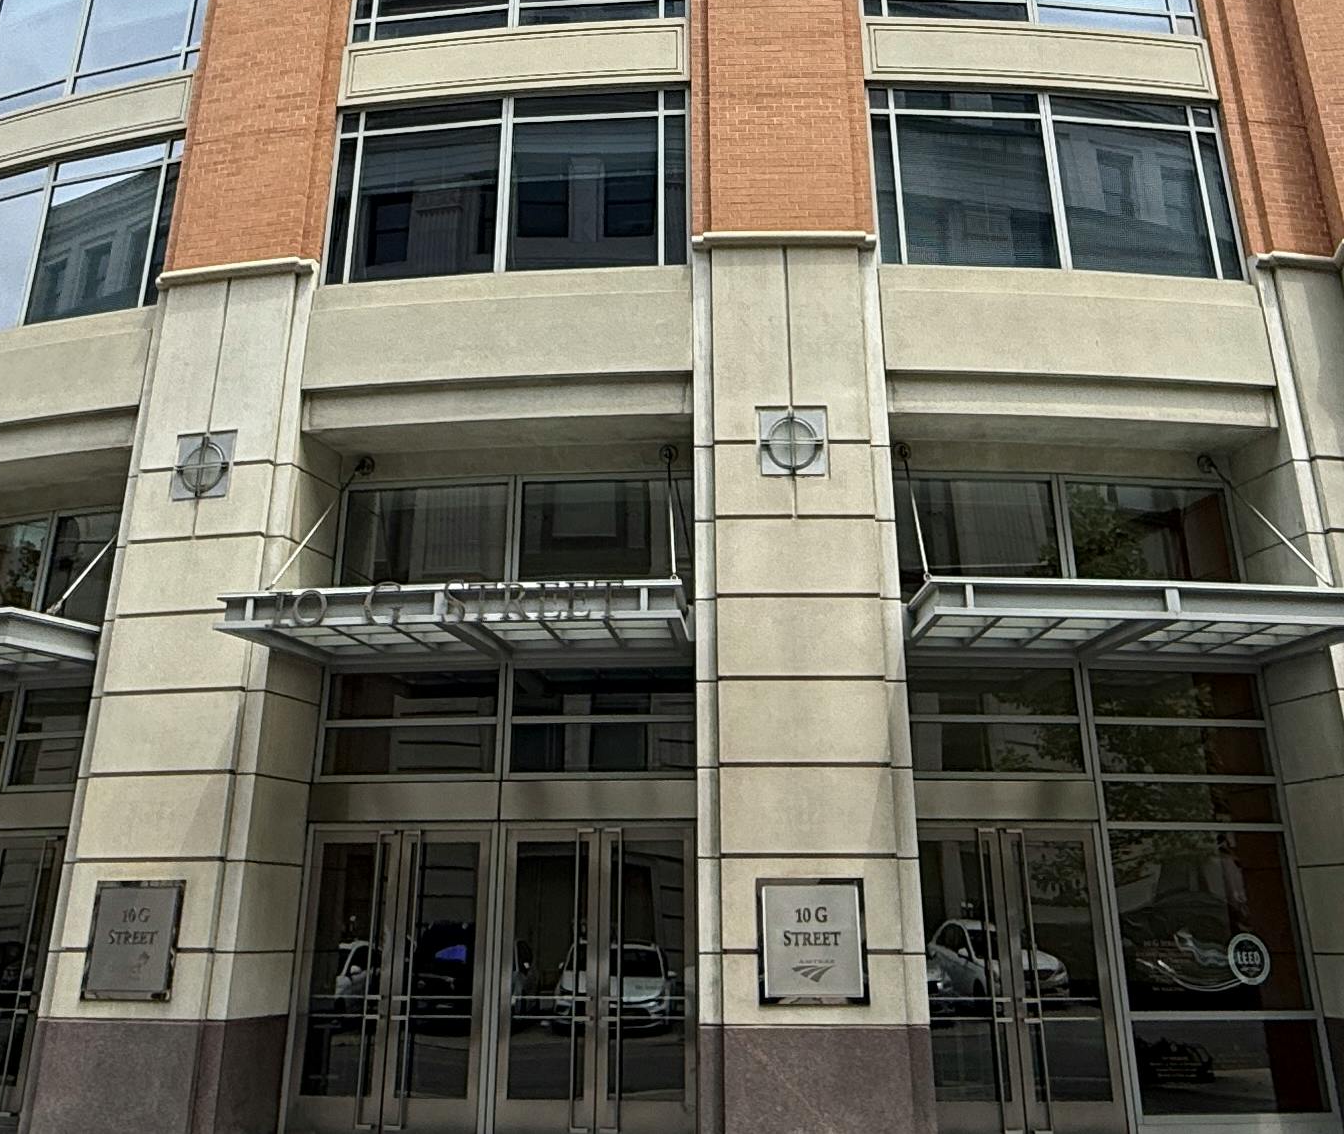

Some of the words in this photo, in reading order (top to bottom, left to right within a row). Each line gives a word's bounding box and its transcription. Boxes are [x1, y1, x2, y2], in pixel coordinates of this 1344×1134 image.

[364, 581, 403, 625] G
[442, 578, 624, 623] STREET
[138, 907, 152, 923] G
[795, 907, 811, 923] 10
[814, 906, 828, 923] G
[108, 930, 159, 945] STREET
[783, 930, 842, 947] STREET
[1236, 951, 1261, 965] LEED
